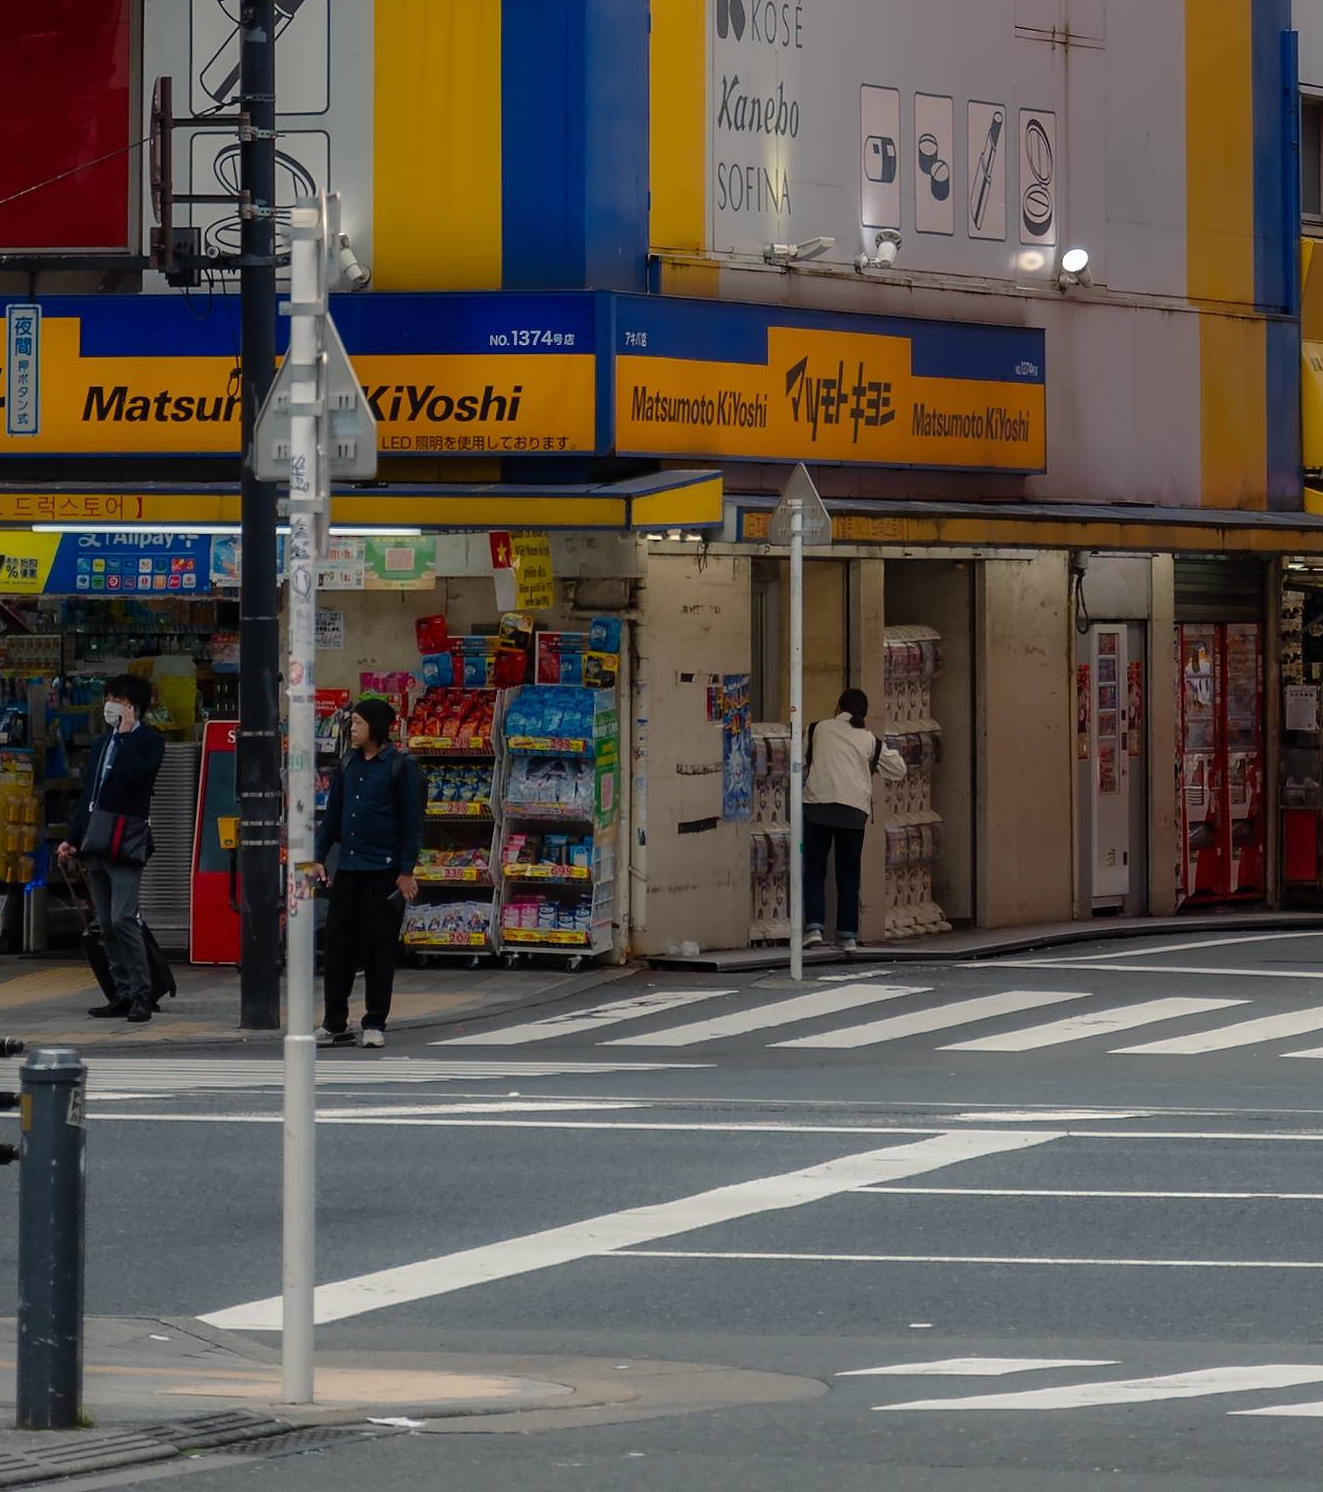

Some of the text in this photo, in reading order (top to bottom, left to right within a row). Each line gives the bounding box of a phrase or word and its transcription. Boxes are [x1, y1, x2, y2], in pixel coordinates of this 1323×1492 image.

[719, 73, 799, 139] Kanebo
[716, 161, 791, 218] SOFINA
[490, 330, 576, 346] NO.1374号店
[15, 316, 33, 425] 夜間 押ボタン式
[631, 387, 768, 429] Matsumoto KiYoshi
[786, 356, 896, 444] マツモトキヨシ
[912, 403, 1030, 443] Matsumoto KiYoshi
[382, 435, 578, 451] LED 照明を使用しております。
